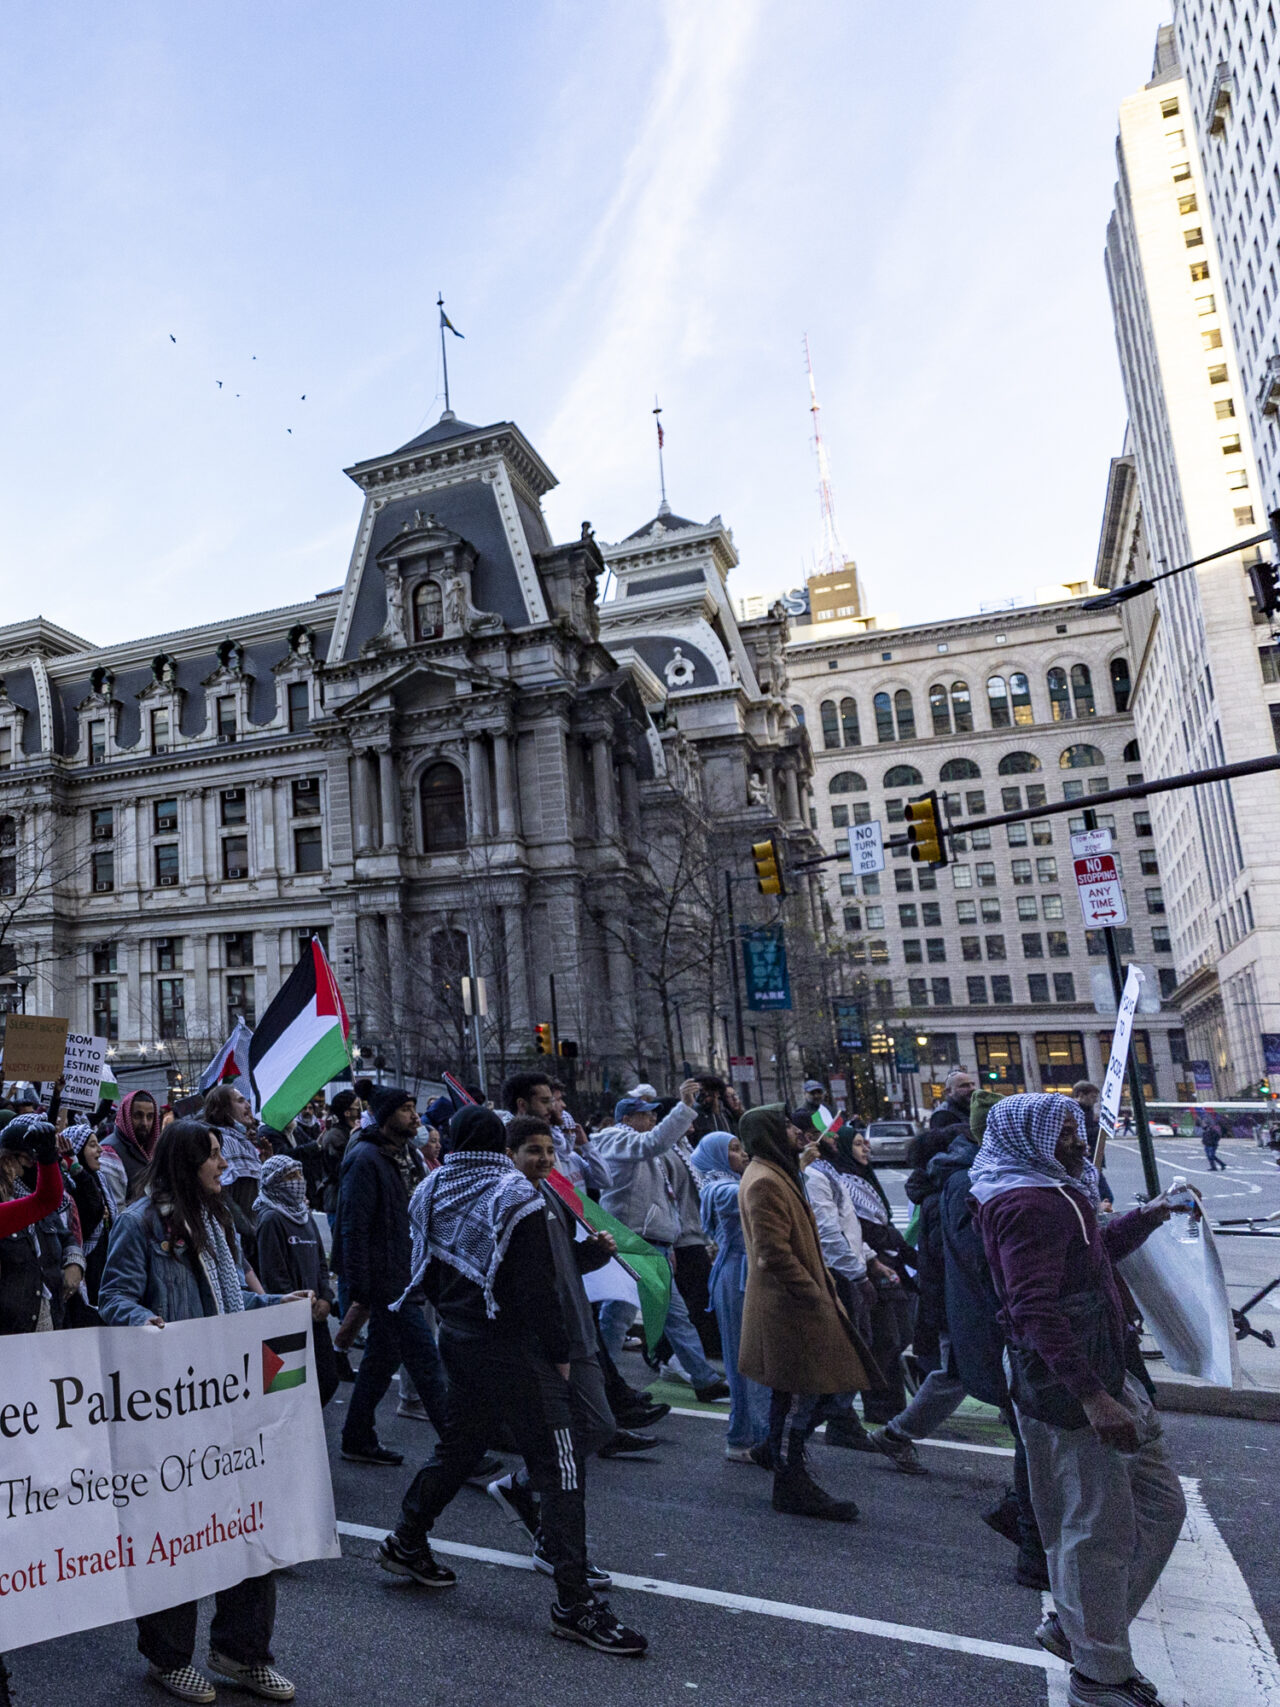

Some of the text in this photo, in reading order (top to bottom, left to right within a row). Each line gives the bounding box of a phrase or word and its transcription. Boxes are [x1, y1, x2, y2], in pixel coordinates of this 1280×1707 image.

[856, 827, 873, 840] NO
[854, 839, 877, 851] TURN
[861, 851, 873, 860] ON
[860, 860, 877, 870] RED
[1085, 858, 1102, 873] NO
[1078, 869, 1116, 885] STOPPING
[1088, 886, 1111, 898] ANY
[1090, 898, 1115, 909] TIME
[755, 990, 785, 1000] PARK
[65, 1047, 85, 1060] ILLY
[87, 1049, 100, 1060] TO
[63, 1059, 100, 1073] ESTINE
[63, 1073, 100, 1087] UPATION
[64, 1085, 93, 1097] CRIME!
[49, 1353, 251, 1431] Palestine!
[67, 1467, 148, 1508] Siege
[159, 1448, 197, 1493] Of
[200, 1433, 266, 1483] Gaza!
[54, 1536, 136, 1583] Israeli
[146, 1501, 265, 1568] Apartheid!
